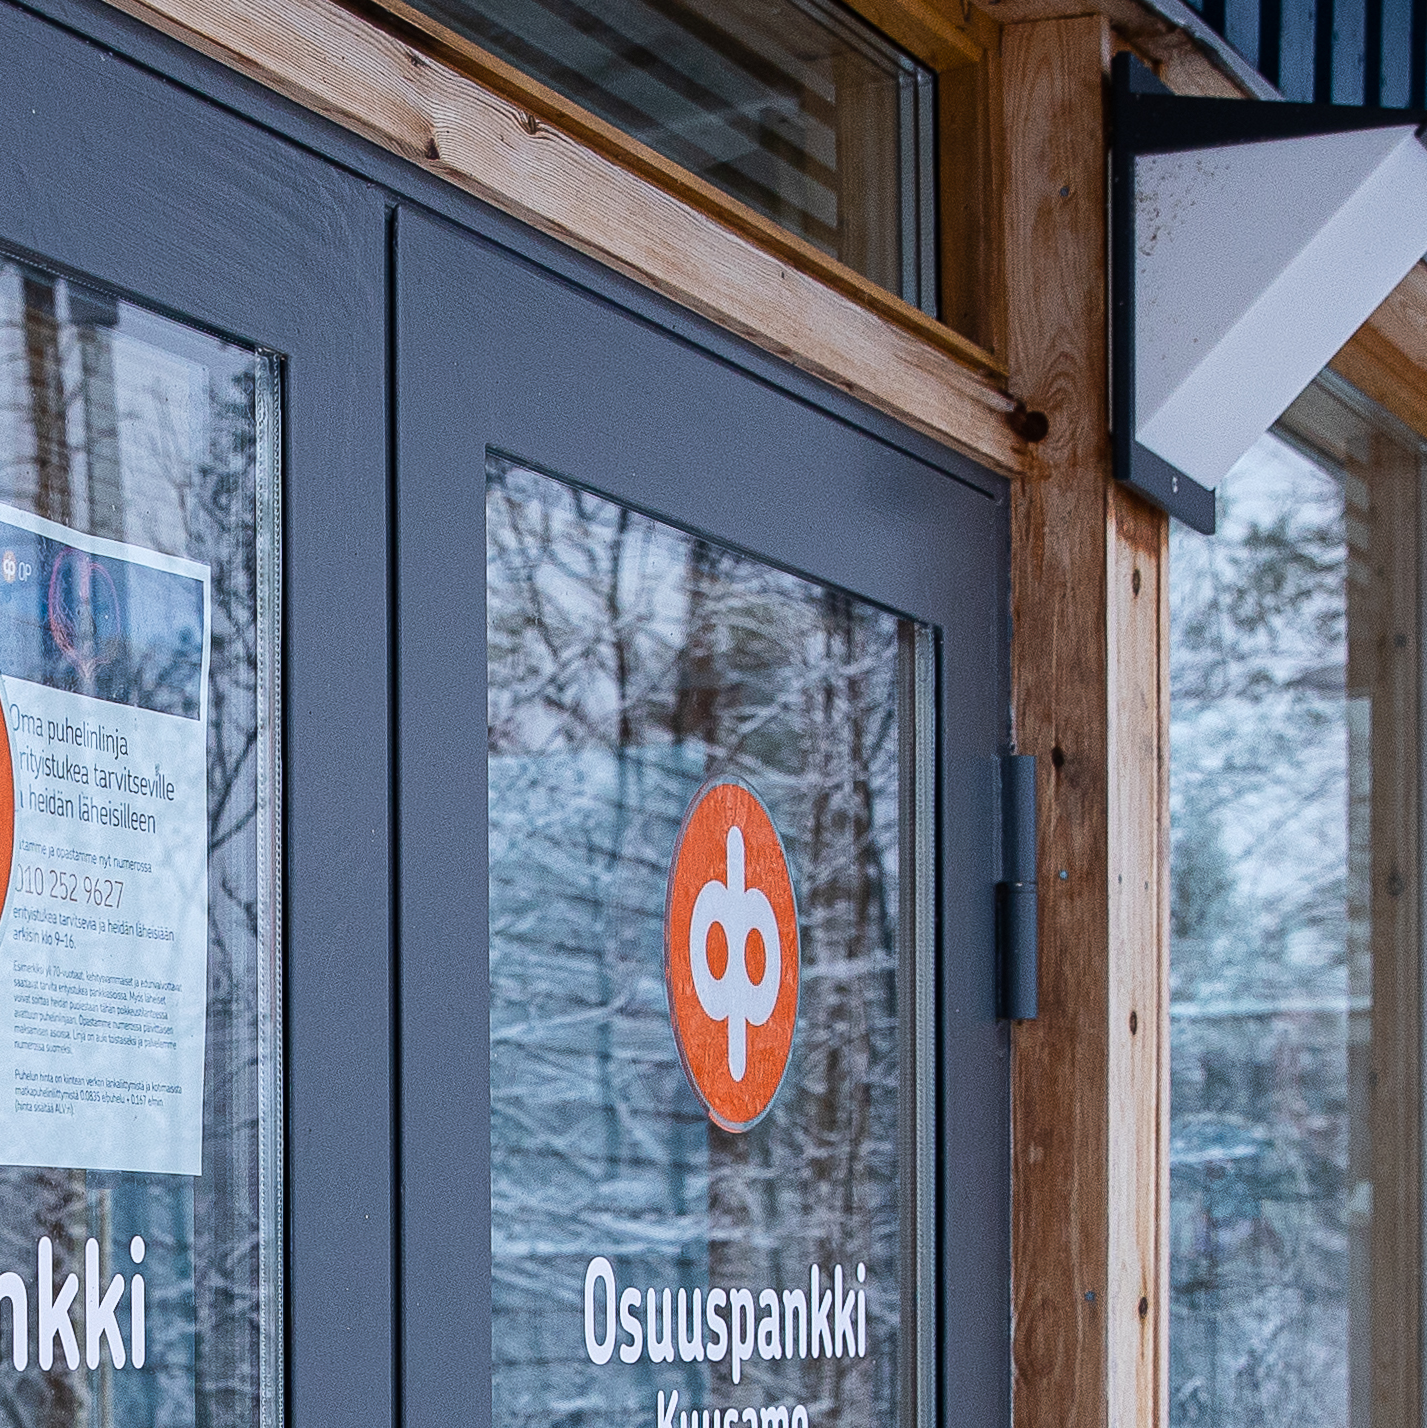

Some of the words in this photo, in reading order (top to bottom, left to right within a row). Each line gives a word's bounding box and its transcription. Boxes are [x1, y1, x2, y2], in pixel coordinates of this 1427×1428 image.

[9, 703, 43, 738] Oma
[47, 717, 129, 760] puhelinlinja
[18, 745, 89, 784] rityistukea
[93, 763, 175, 801] tarvitseville
[29, 784, 74, 818] heidän
[78, 791, 156, 834] läheisilleen
[18, 839, 47, 855] tamme
[49, 869, 78, 903] 252
[83, 876, 124, 909] 9627
[583, 1255, 866, 1386] Osuuspankki
